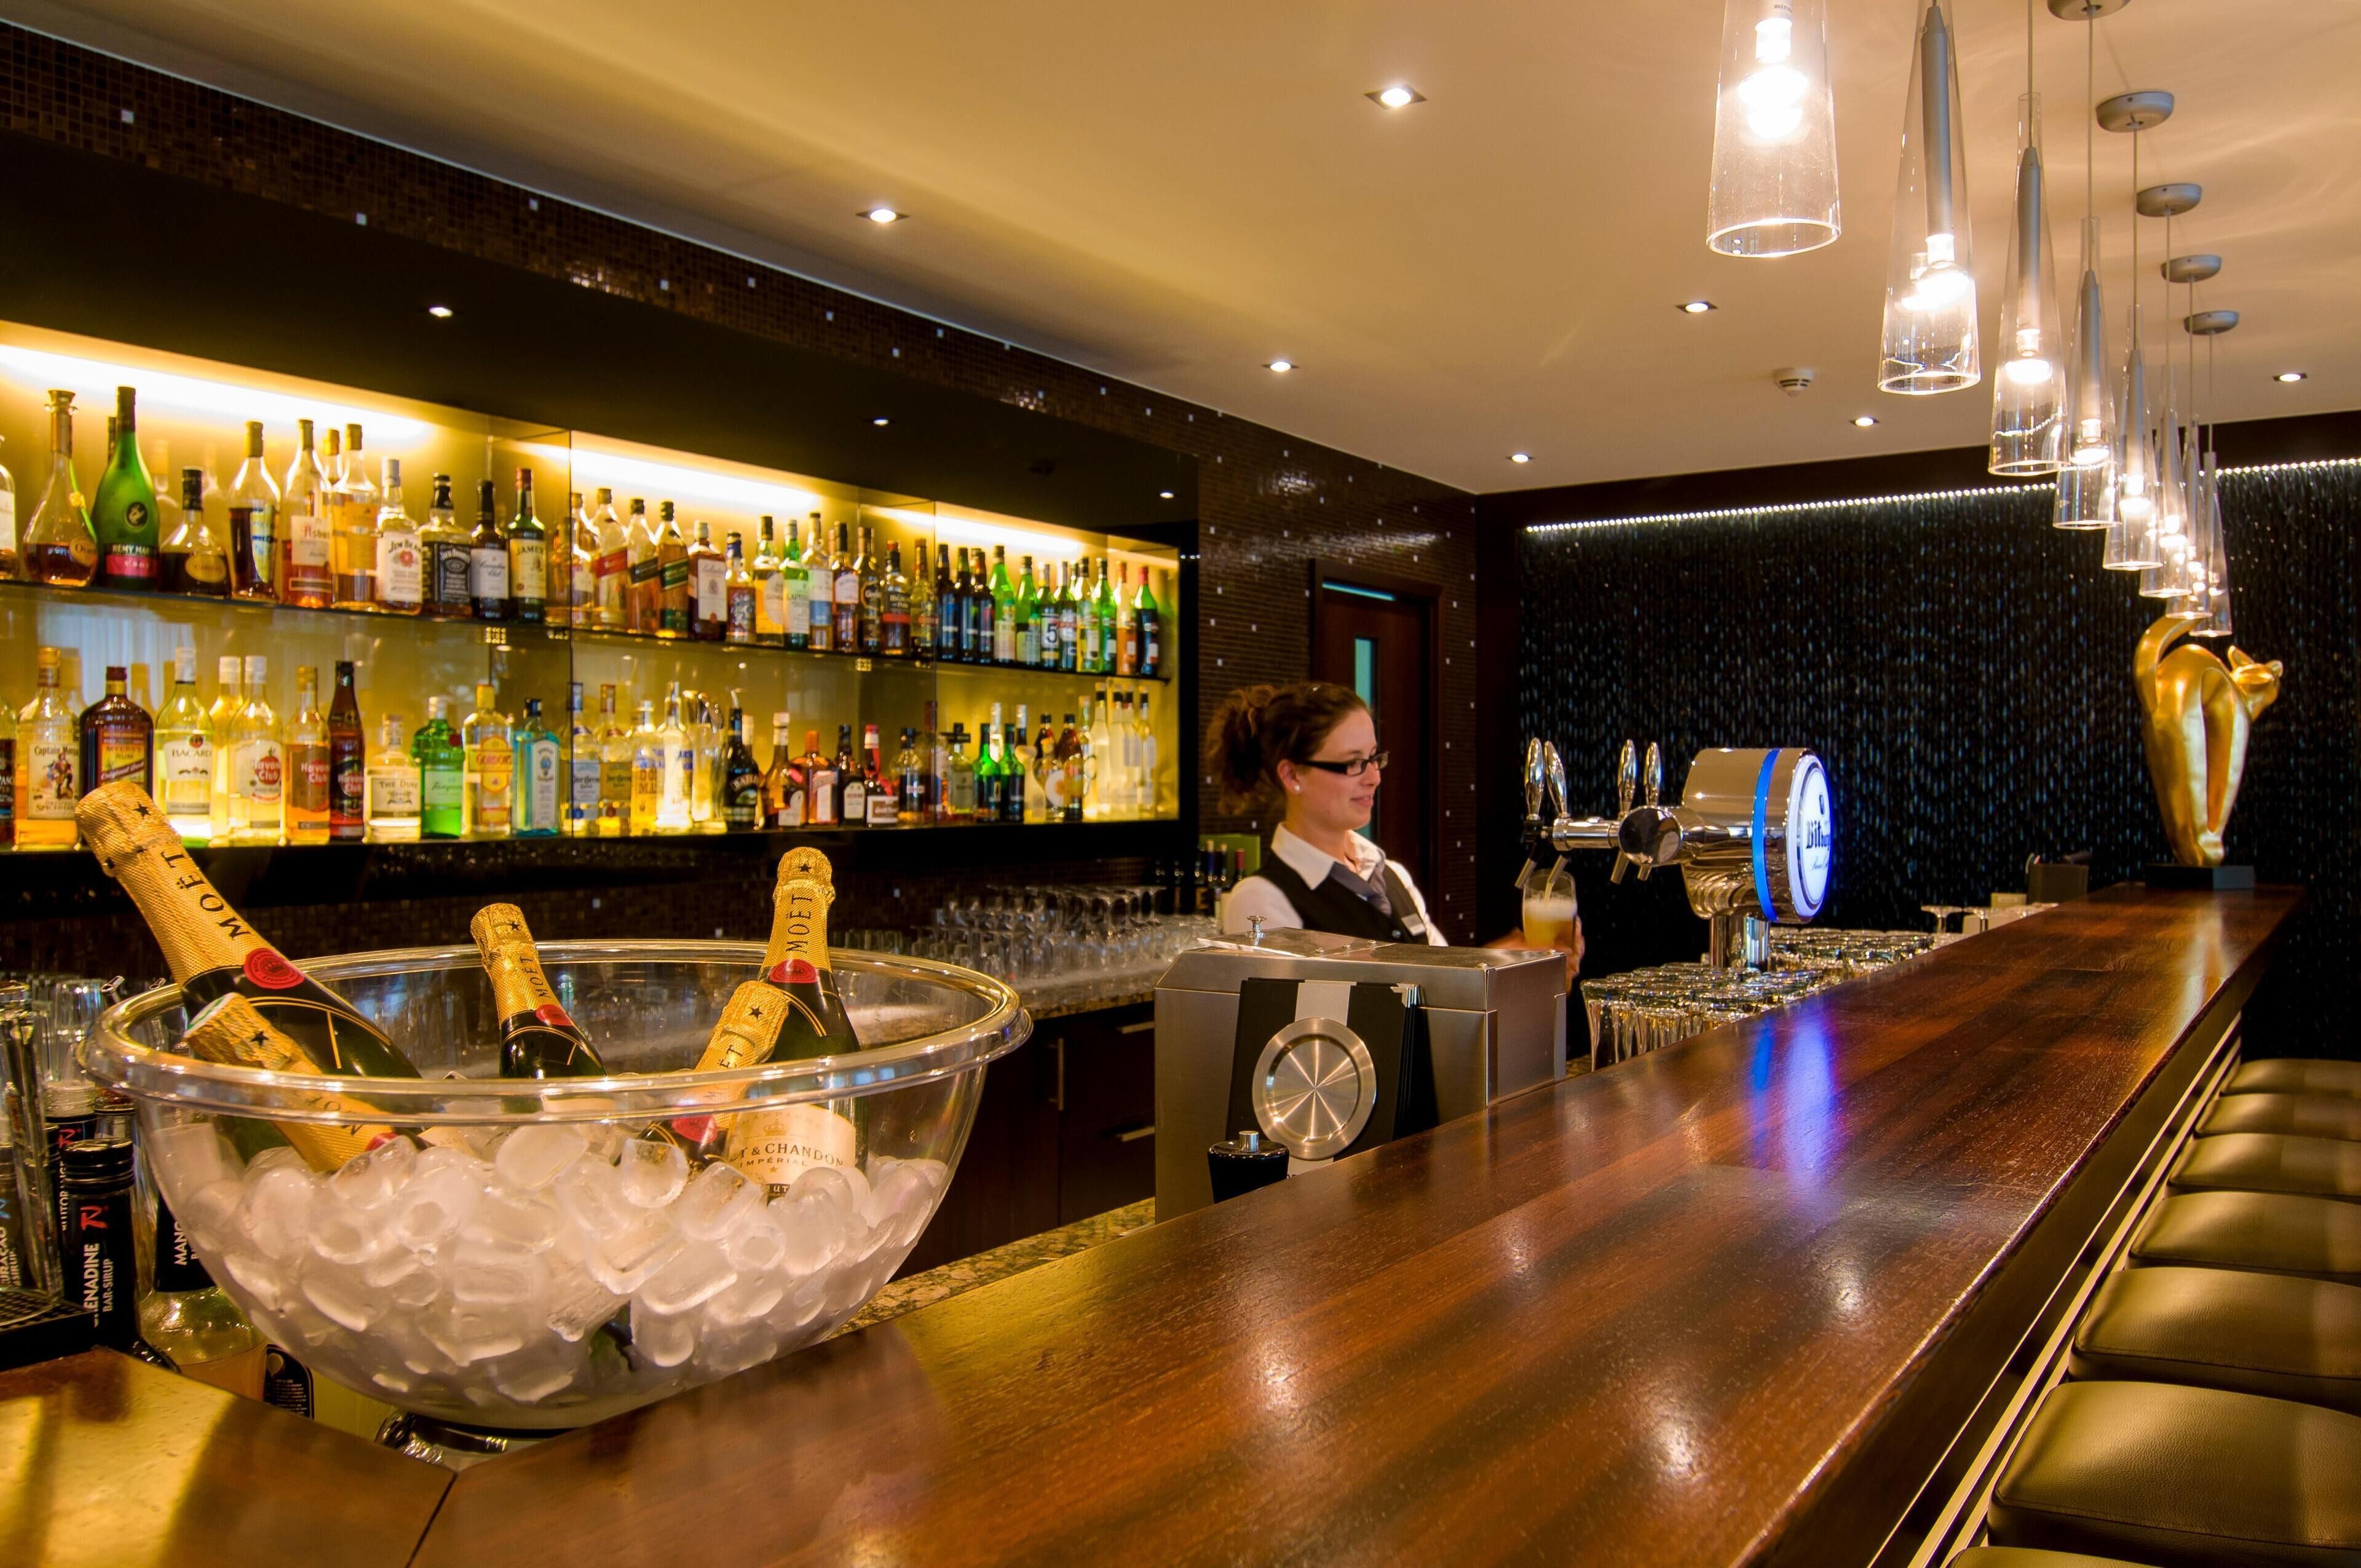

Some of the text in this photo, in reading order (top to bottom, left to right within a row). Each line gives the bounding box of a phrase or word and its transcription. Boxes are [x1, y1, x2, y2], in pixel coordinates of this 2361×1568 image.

[34, 745, 60, 756] Captain
[160, 850, 251, 940] MOËT
[785, 893, 813, 954] MOËT
[520, 955, 552, 999] MOËT
[740, 1157, 808, 1168] IMPÉRIAL
